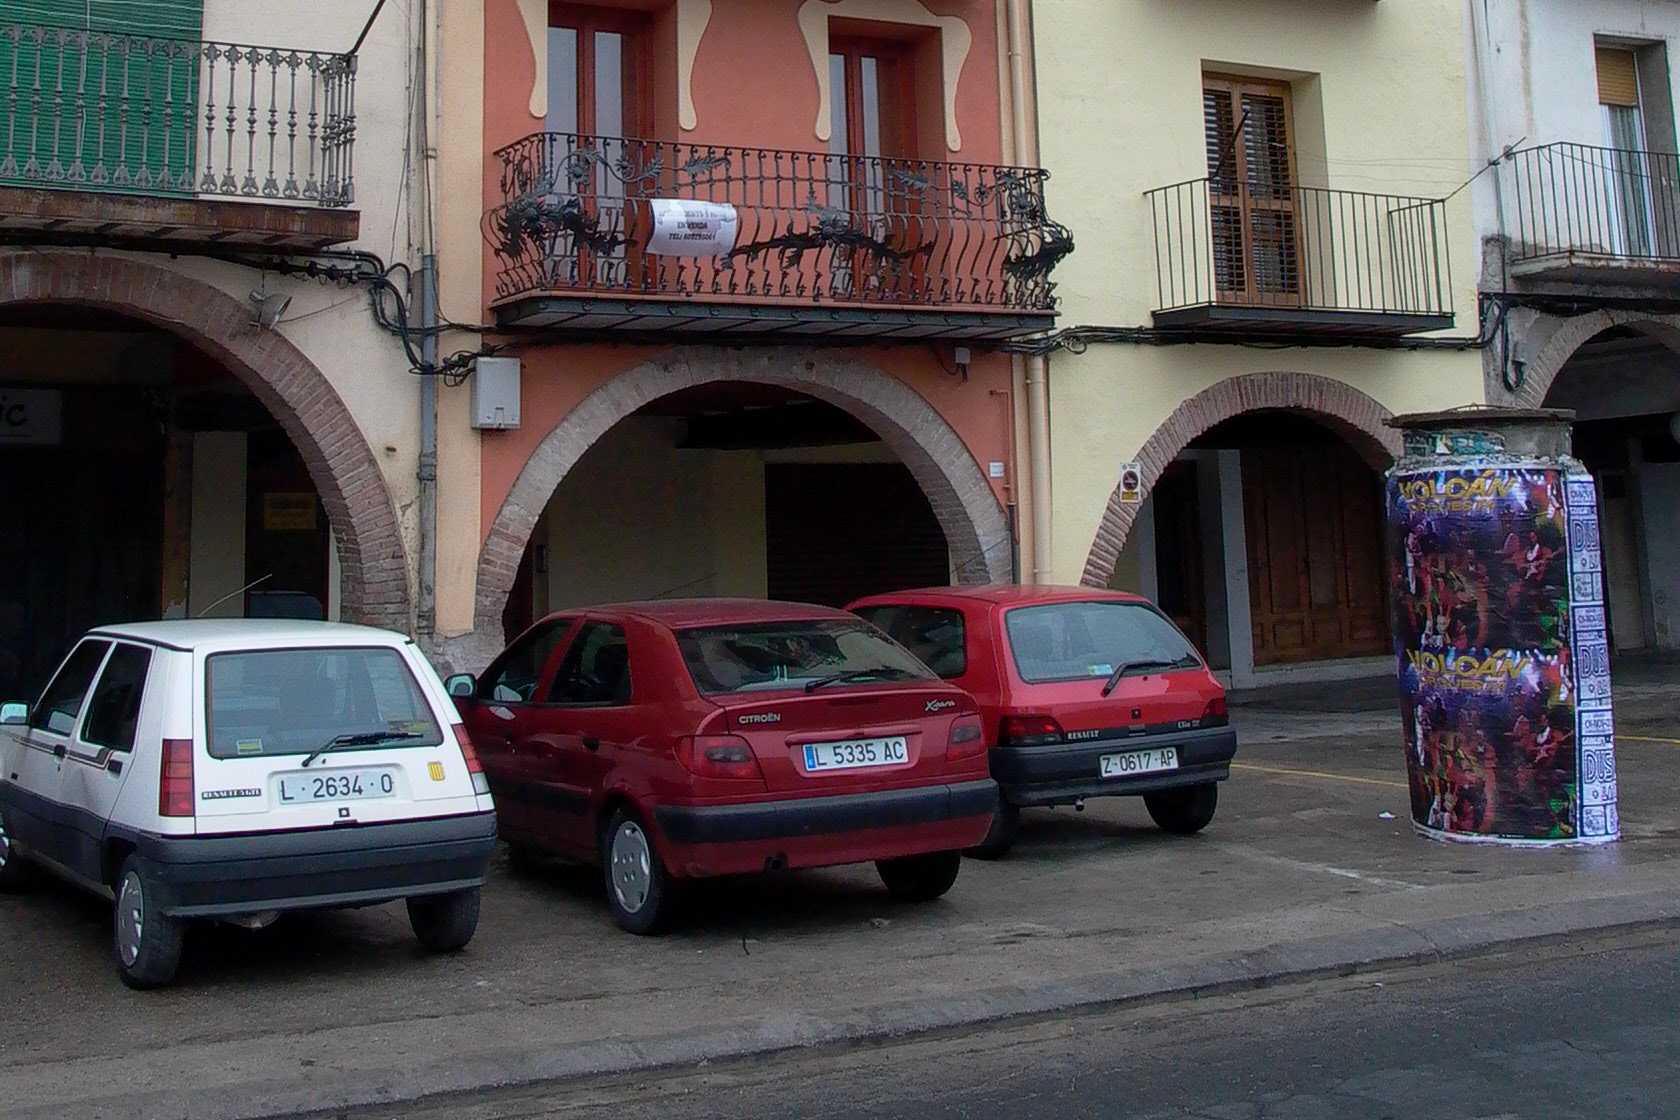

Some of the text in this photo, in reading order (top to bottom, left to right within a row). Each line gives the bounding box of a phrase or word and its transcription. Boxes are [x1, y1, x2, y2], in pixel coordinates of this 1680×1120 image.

[1399, 468, 1515, 499] VOLCÁN
[1406, 648, 1529, 678] VOLCÁN
[738, 712, 781, 724] CITROËN
[1067, 730, 1100, 740] RENAULT
[814, 738, 904, 766] L 5335 AC
